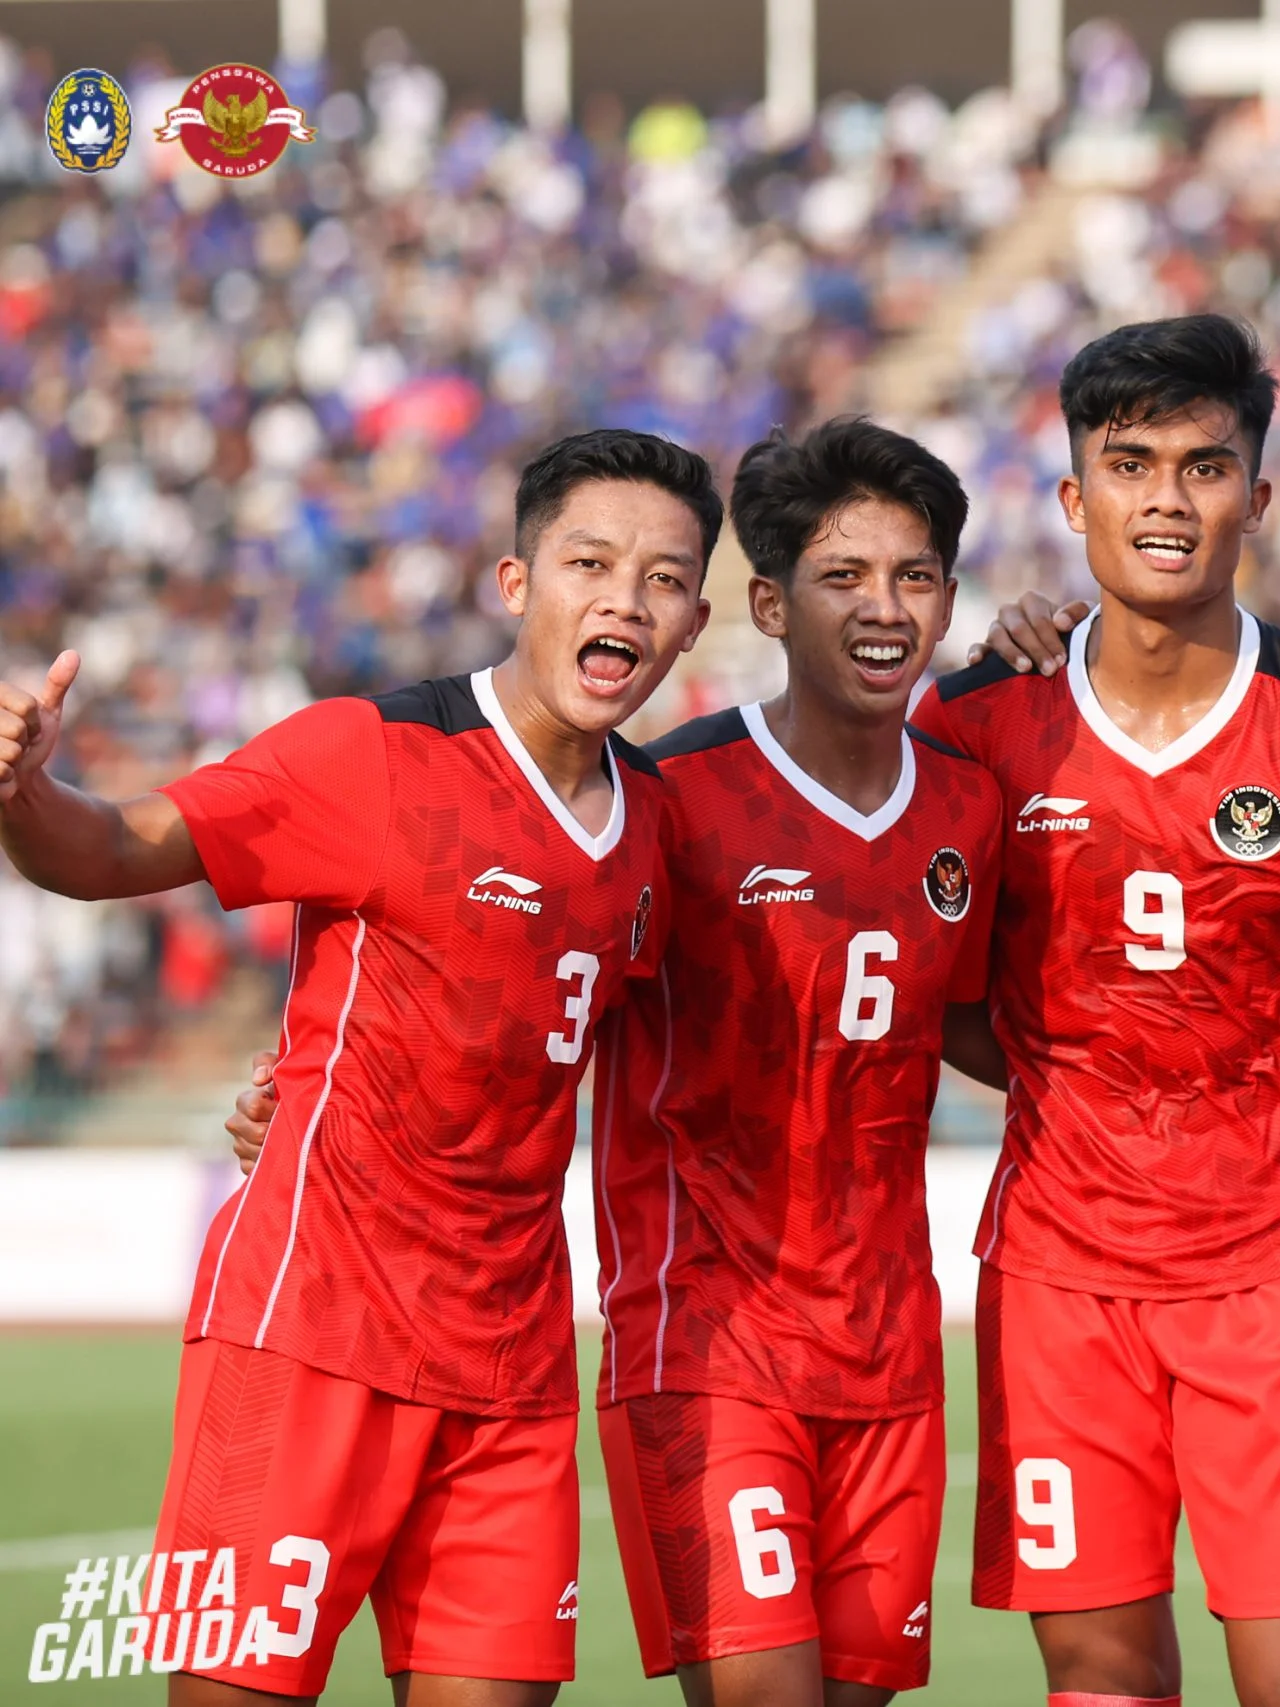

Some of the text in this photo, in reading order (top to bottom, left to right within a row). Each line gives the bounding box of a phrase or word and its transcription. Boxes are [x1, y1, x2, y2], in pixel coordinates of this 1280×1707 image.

[1016, 817, 1091, 832] LI-NING
[1218, 792, 1234, 811] TIM
[467, 886, 543, 915] LI-NING
[738, 888, 815, 905] LI-NING
[1123, 869, 1187, 971] 9
[545, 950, 600, 1065] 3
[838, 930, 899, 1041] 6
[728, 1485, 797, 1600] 6
[1014, 1457, 1078, 1570] 9
[262, 1534, 331, 1659] 3
